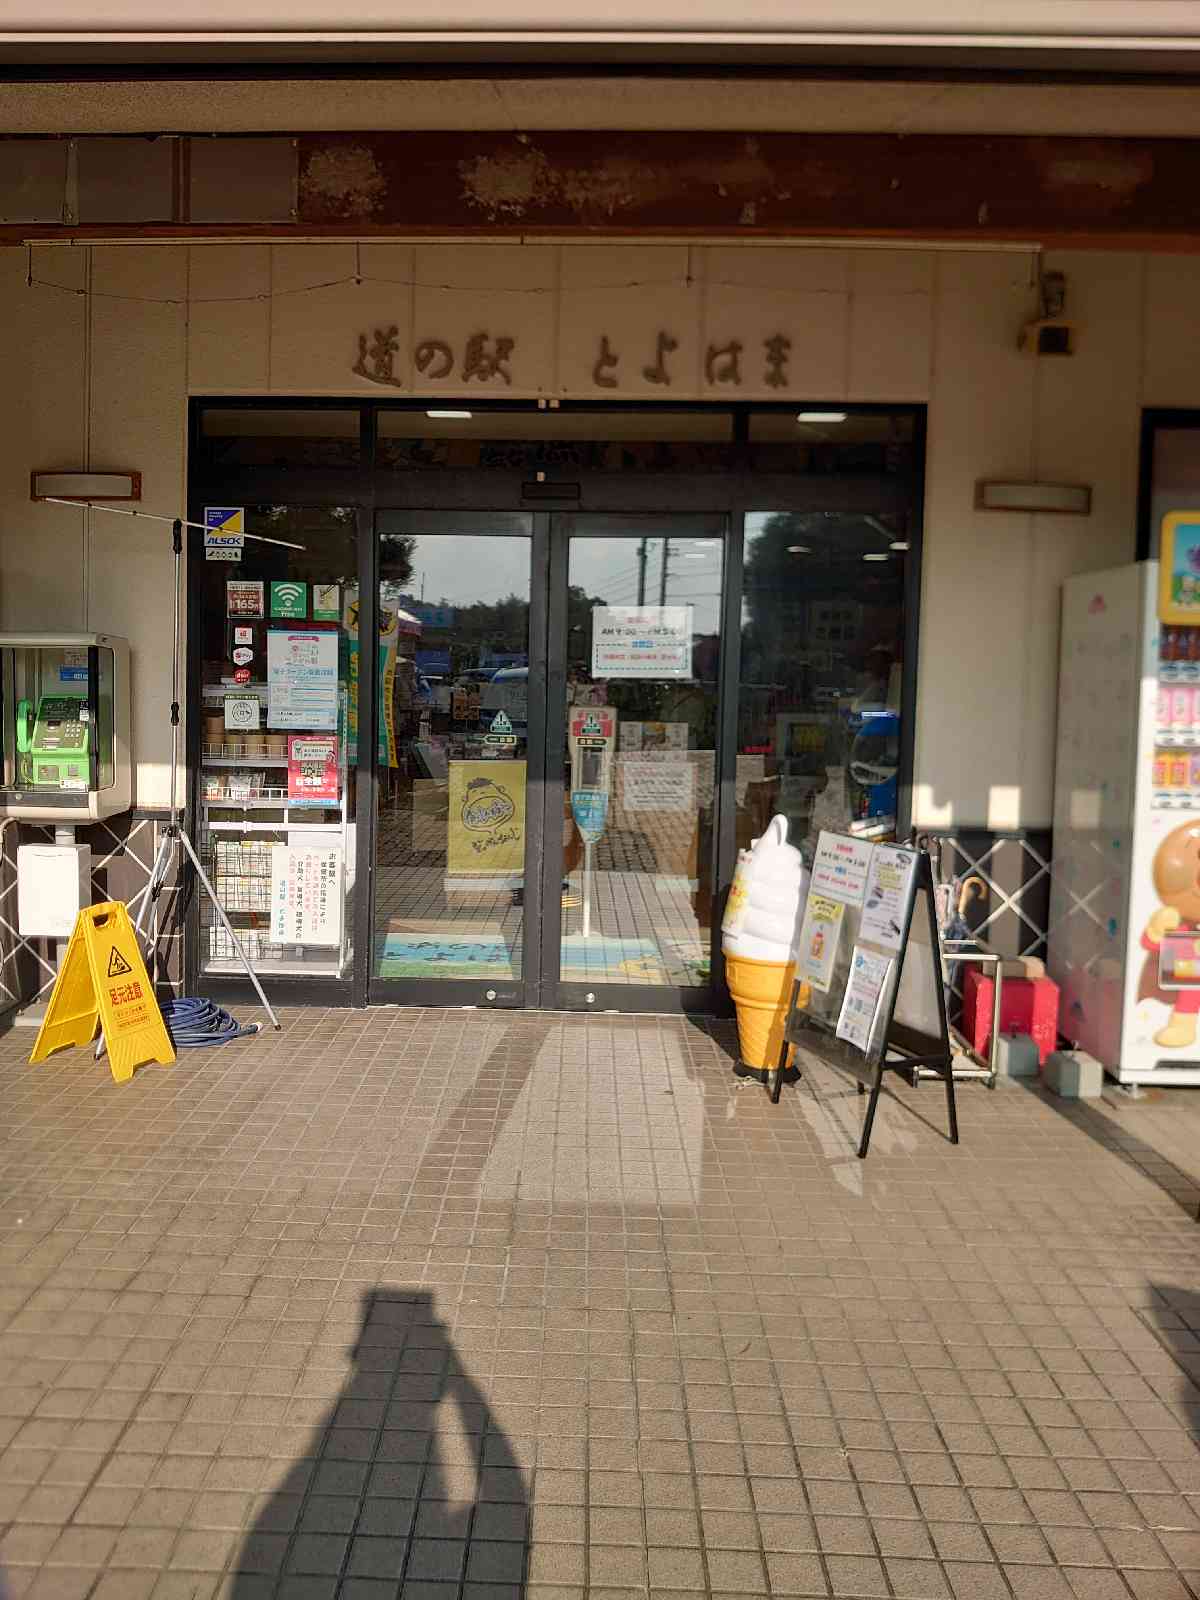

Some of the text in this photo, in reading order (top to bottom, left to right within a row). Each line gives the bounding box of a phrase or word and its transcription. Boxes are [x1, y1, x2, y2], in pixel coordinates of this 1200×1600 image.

[352, 325, 791, 388] 道の駅 とよはま
[207, 536, 241, 545] ALSOK
